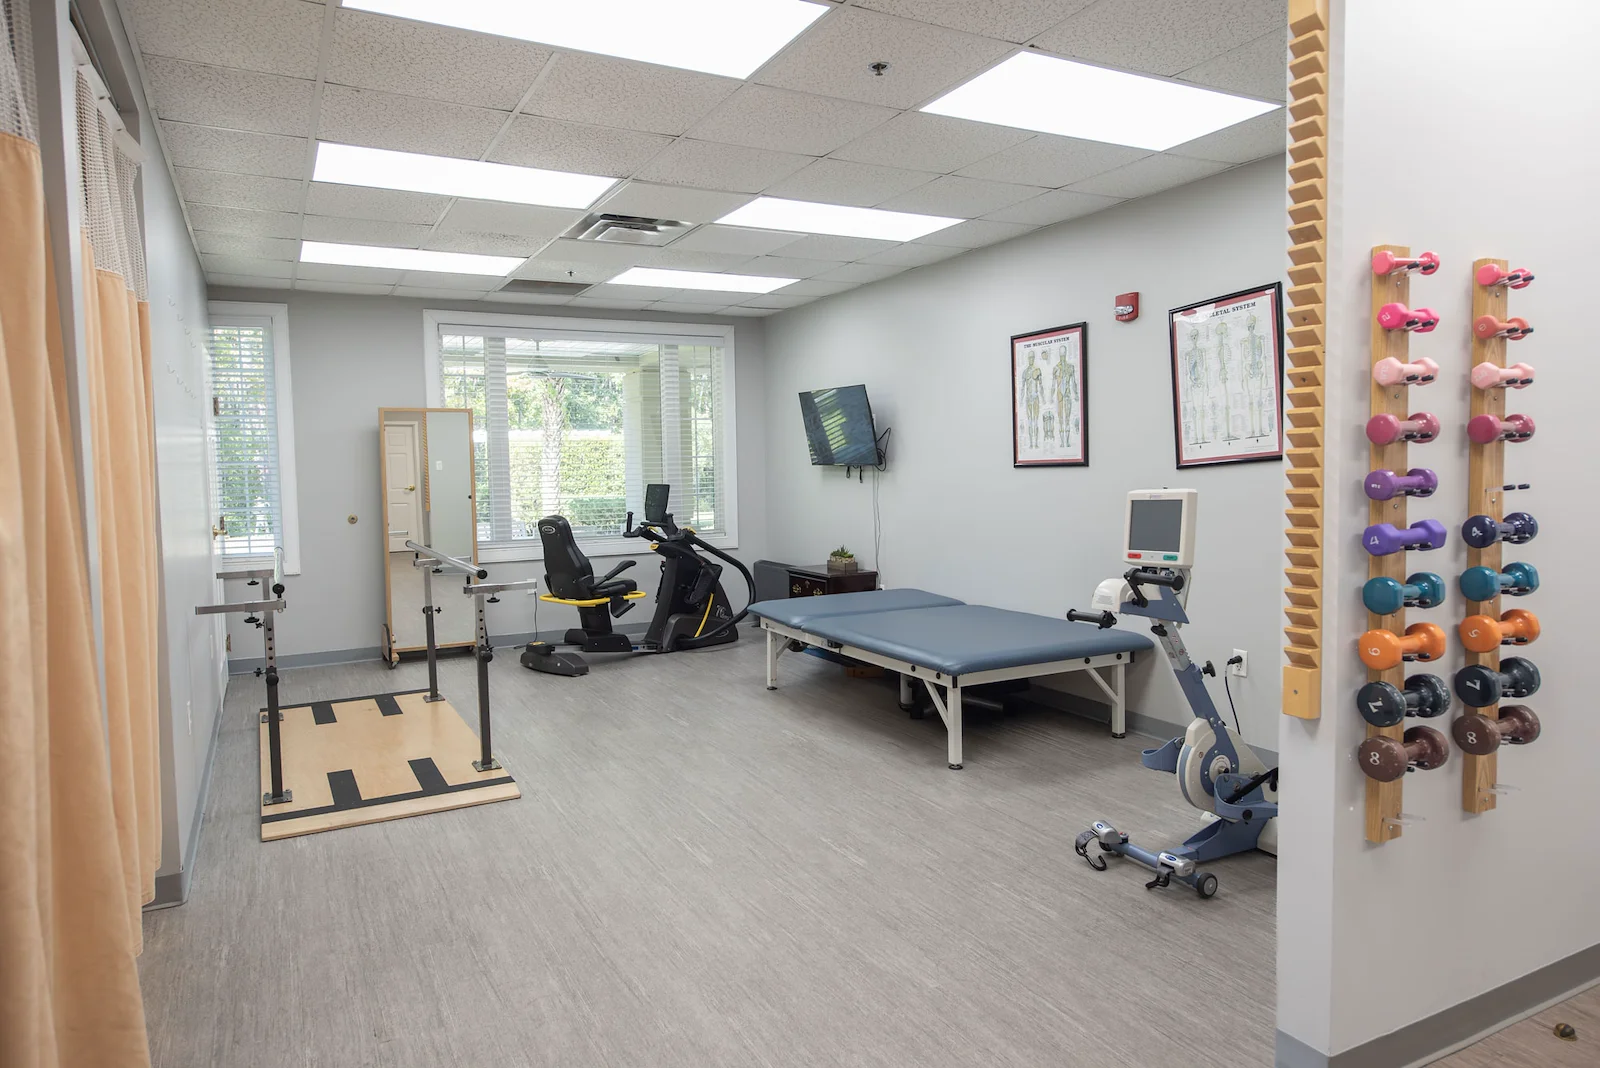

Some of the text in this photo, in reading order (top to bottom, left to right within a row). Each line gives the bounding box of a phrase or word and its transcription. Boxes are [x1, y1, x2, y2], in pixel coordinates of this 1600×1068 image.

[1231, 302, 1256, 312] SYSTEM
[1032, 339, 1053, 347] MUSCULAR
[1053, 336, 1070, 344] SYSTEM
[1472, 526, 1483, 537] 4
[1370, 535, 1379, 545] 4
[1367, 647, 1381, 656] 6
[1466, 679, 1481, 691] 7
[1367, 699, 1384, 713] 7
[1466, 731, 1477, 745] 8
[1369, 751, 1380, 765] 8
